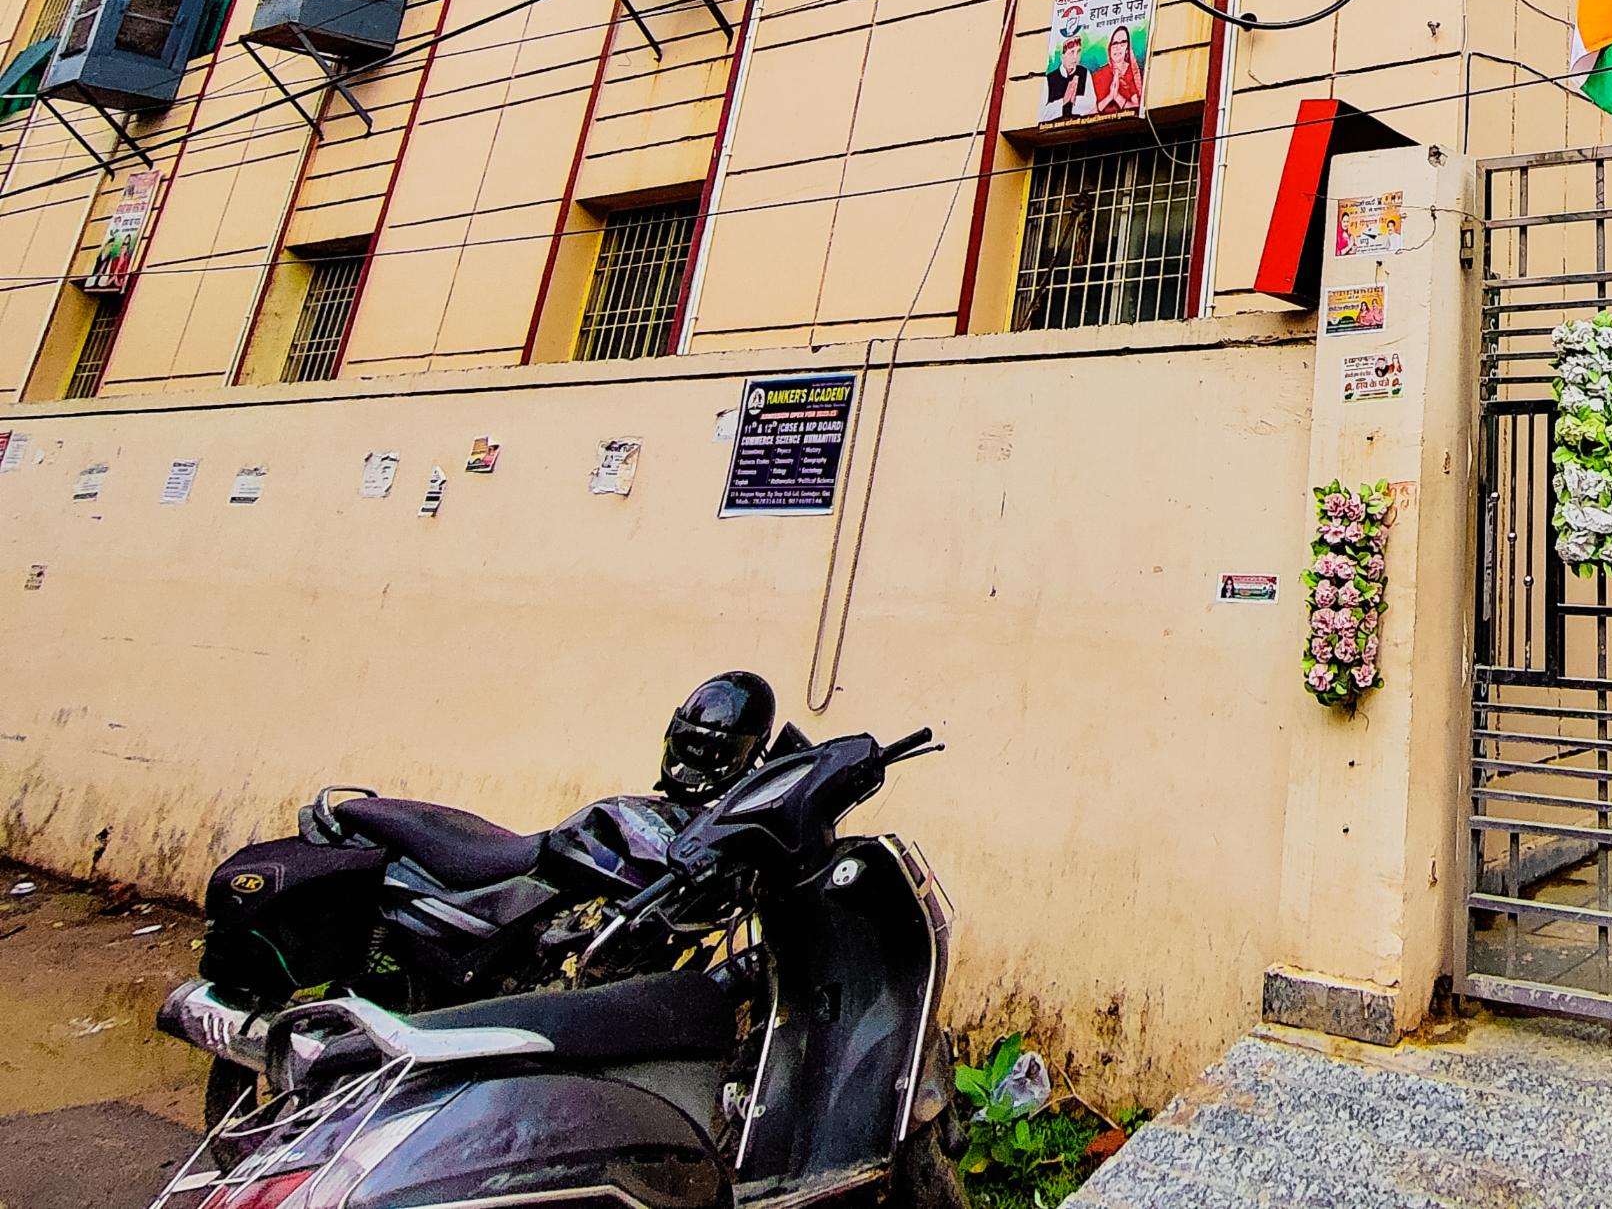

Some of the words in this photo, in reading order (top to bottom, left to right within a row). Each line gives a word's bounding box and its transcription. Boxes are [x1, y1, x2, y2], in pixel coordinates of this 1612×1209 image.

[1089, 4, 1109, 21] हाथ
[767, 389, 807, 404] RANKER'S
[808, 386, 851, 402] ACADEMY
